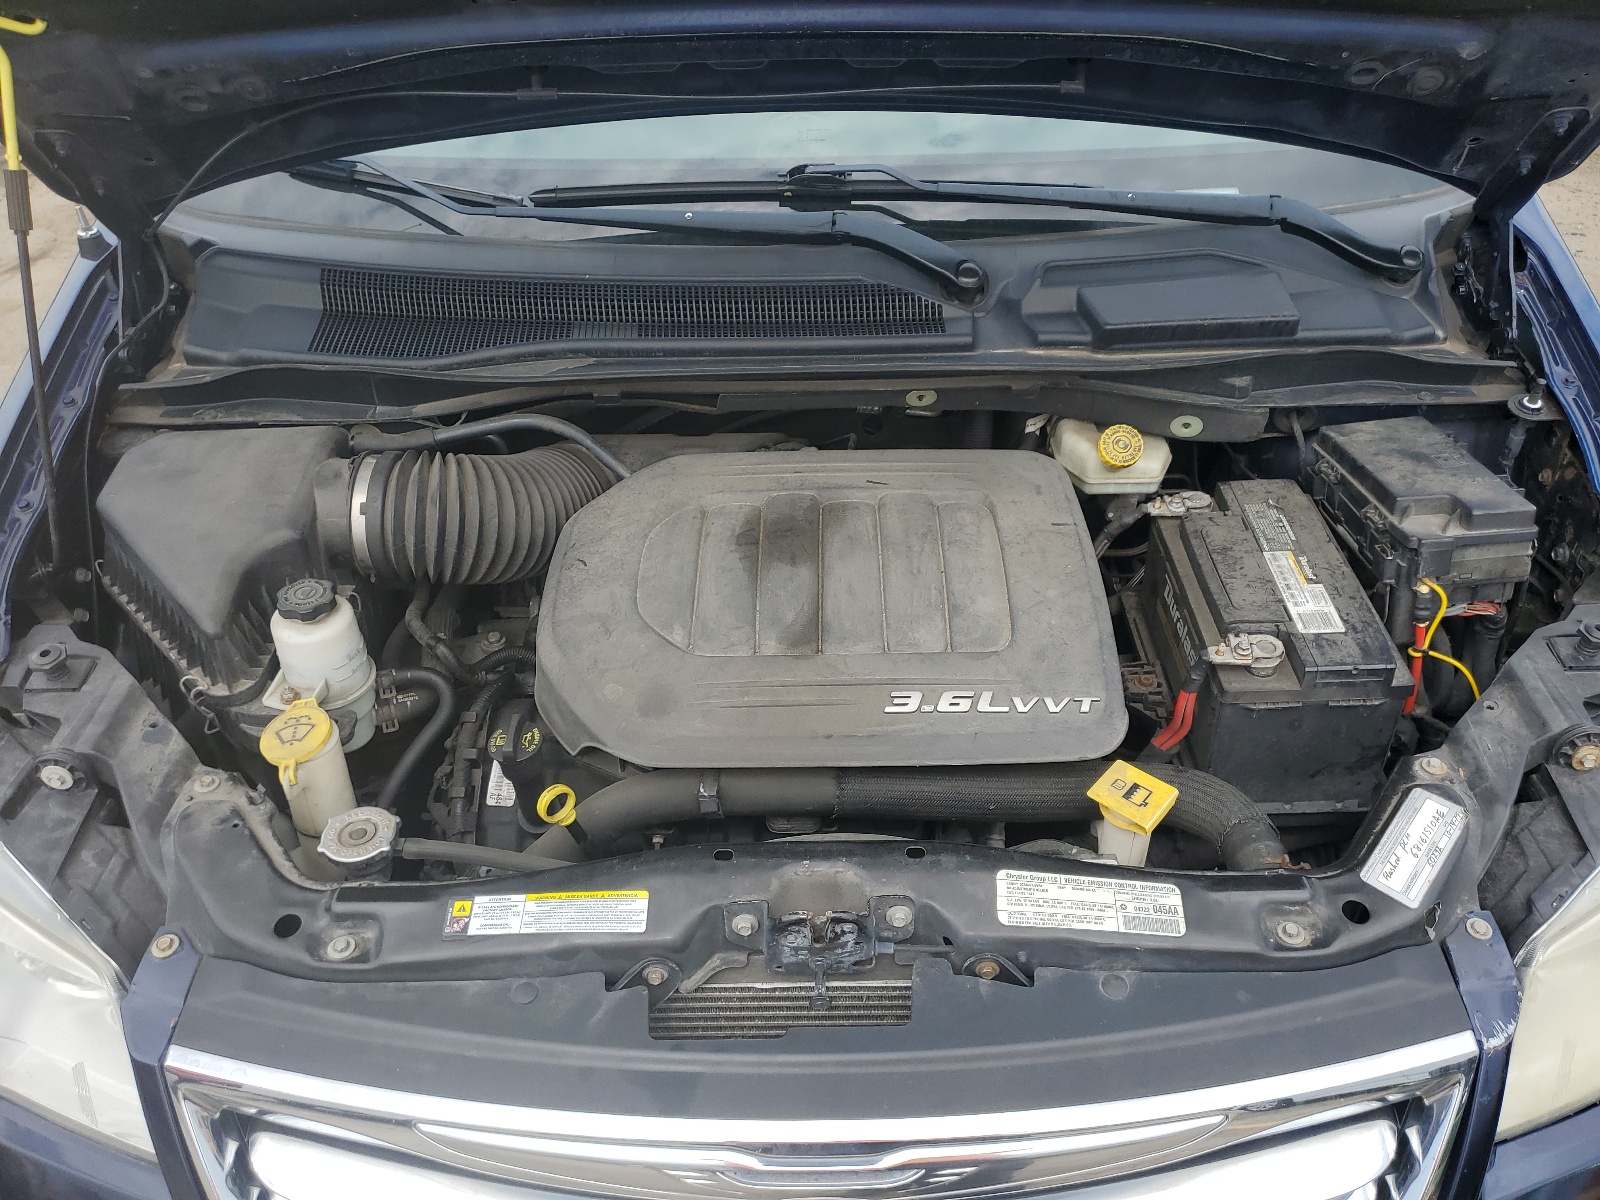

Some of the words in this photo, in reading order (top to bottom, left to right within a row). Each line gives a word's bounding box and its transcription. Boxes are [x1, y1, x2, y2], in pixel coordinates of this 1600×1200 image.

[1164, 573, 1199, 667] Duralas
[884, 691, 1010, 713] 3.6L
[1011, 696, 1101, 713] VVT
[1064, 877, 1086, 885] VEHICLE
[1087, 879, 1113, 887] EMISSION
[1113, 882, 1138, 890] CONTROL
[1139, 884, 1176, 893] INFORMATION
[1152, 904, 1179, 915] 045AA
